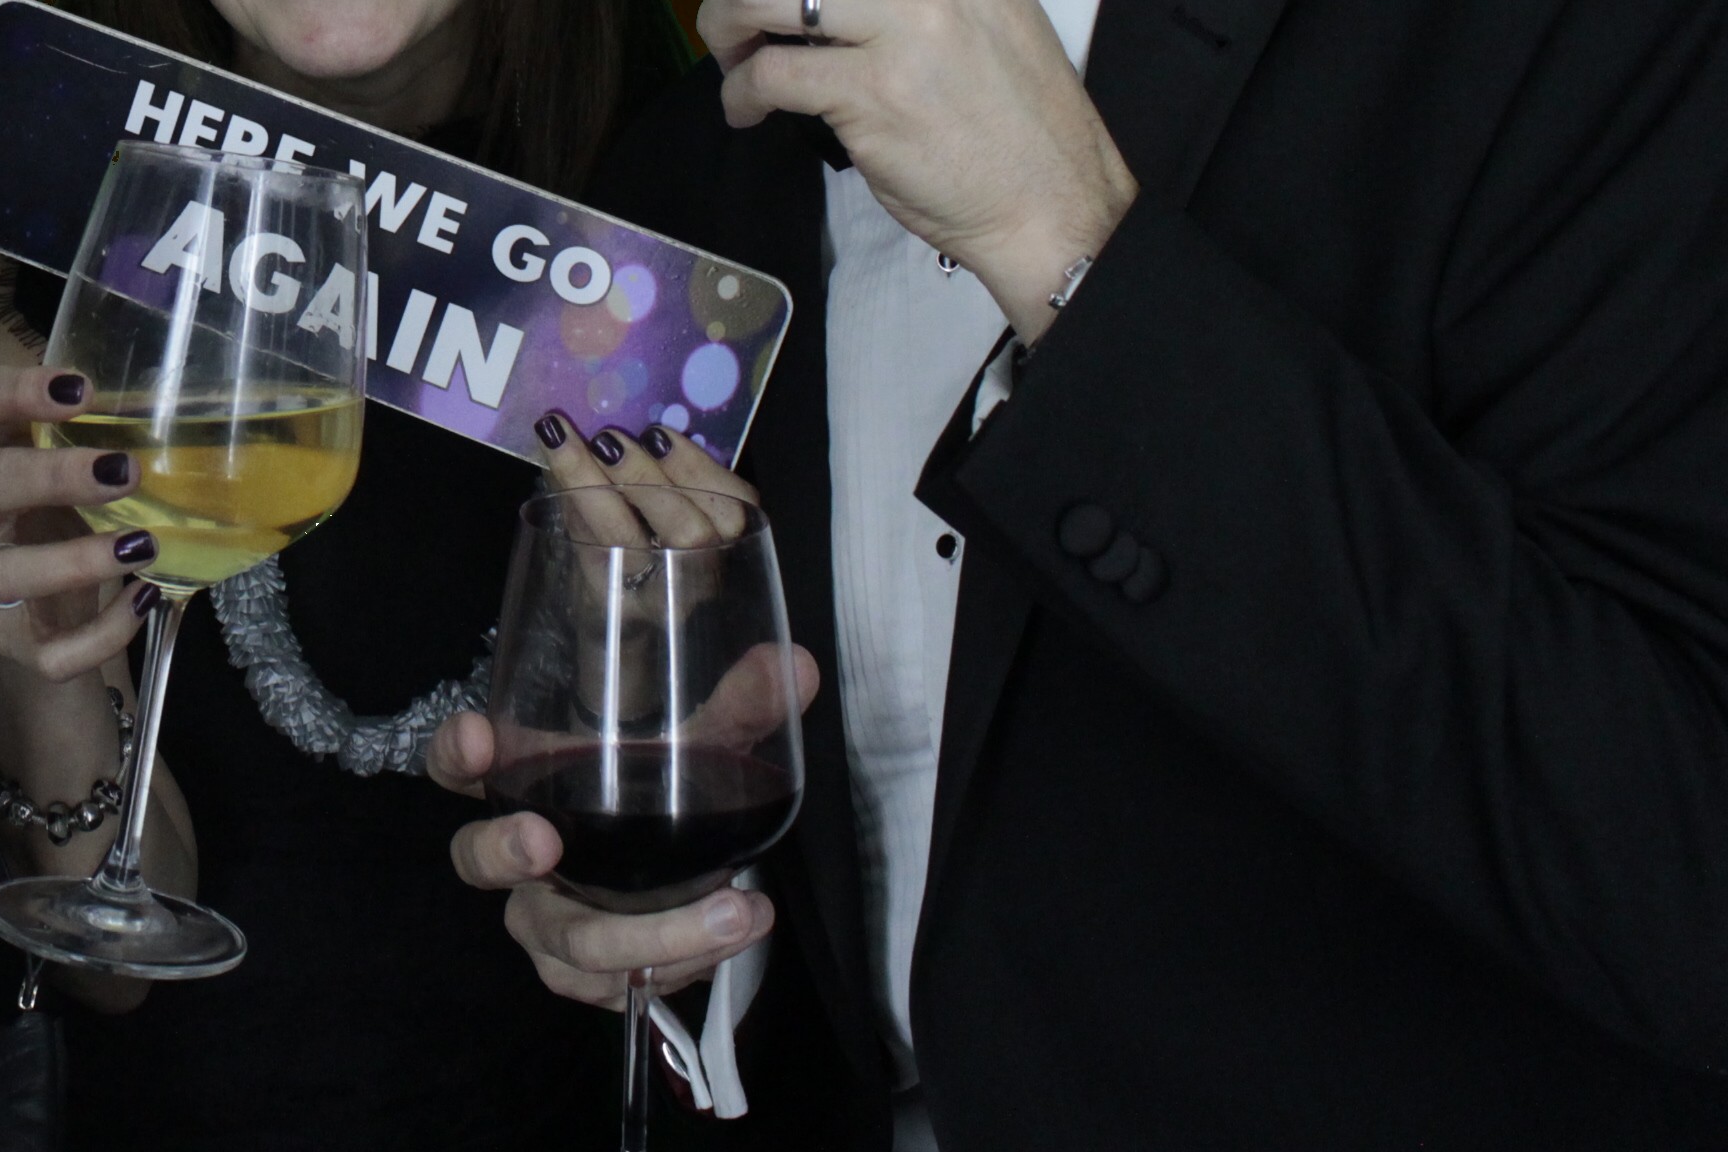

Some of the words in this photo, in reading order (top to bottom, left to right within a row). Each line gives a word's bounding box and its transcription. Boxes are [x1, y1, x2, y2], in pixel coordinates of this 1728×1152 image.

[125, 79, 316, 176] HERE
[347, 159, 468, 254] WE
[491, 225, 613, 306] GO
[140, 199, 525, 409] AGAIN
